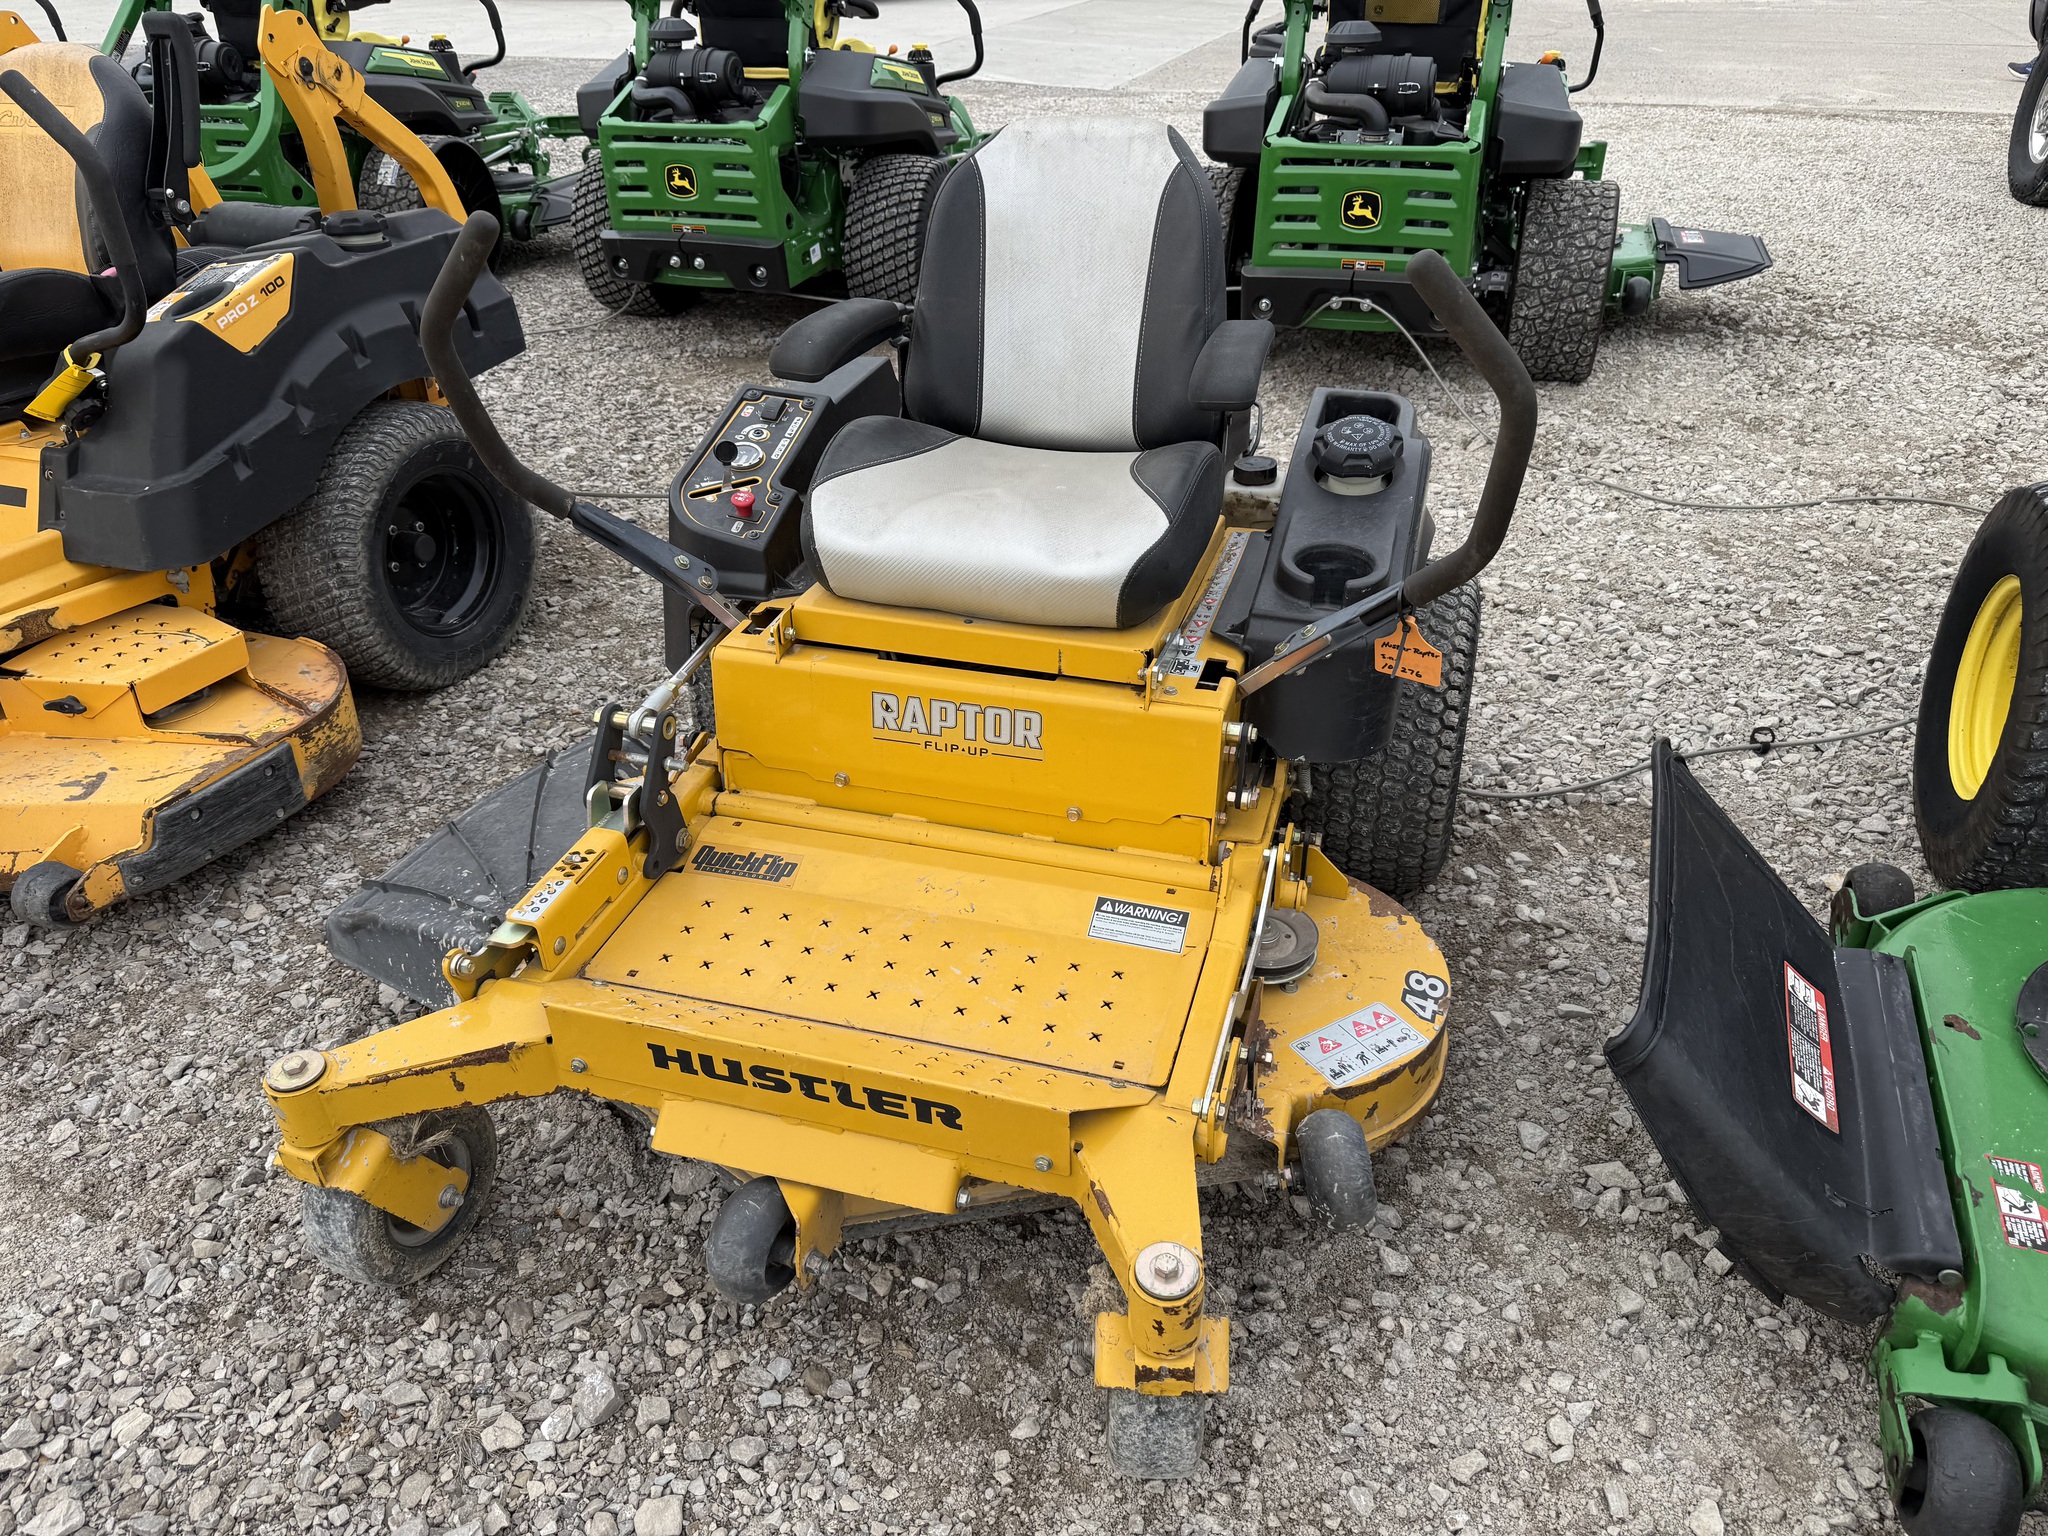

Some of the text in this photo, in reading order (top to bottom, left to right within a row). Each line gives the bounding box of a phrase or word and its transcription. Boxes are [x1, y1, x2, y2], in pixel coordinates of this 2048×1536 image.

[216, 275, 286, 330] PRO Z 100
[871, 691, 1043, 751] RAPTOR
[691, 845, 799, 883] QuickFlip
[1114, 902, 1184, 925] WARNING!
[1403, 970, 1449, 1023] 48
[1817, 1010, 1829, 1043] DANGER
[646, 1042, 964, 1131] HUSTLER
[1823, 1073, 1836, 1112] PELIGRO
